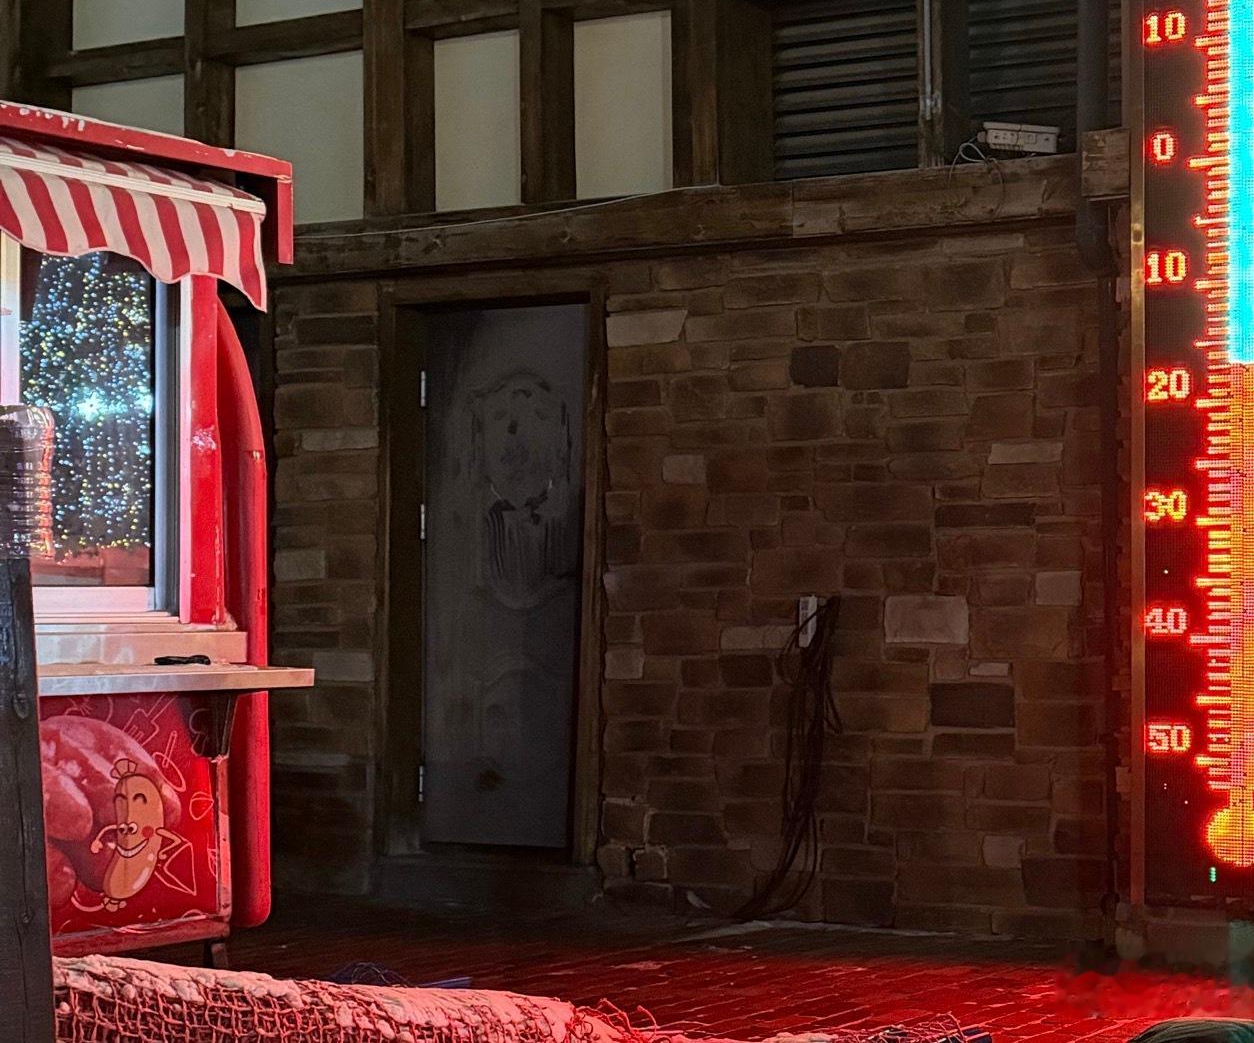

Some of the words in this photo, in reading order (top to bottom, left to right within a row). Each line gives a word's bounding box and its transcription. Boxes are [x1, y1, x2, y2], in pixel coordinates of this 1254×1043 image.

[1145, 12, 1187, 43] 10
[1152, 132, 1176, 162] 0
[1146, 251, 1187, 284] 10
[1147, 369, 1190, 402] 20
[1144, 490, 1188, 522] 30
[1144, 607, 1188, 636] 40
[1147, 724, 1191, 754] 50
